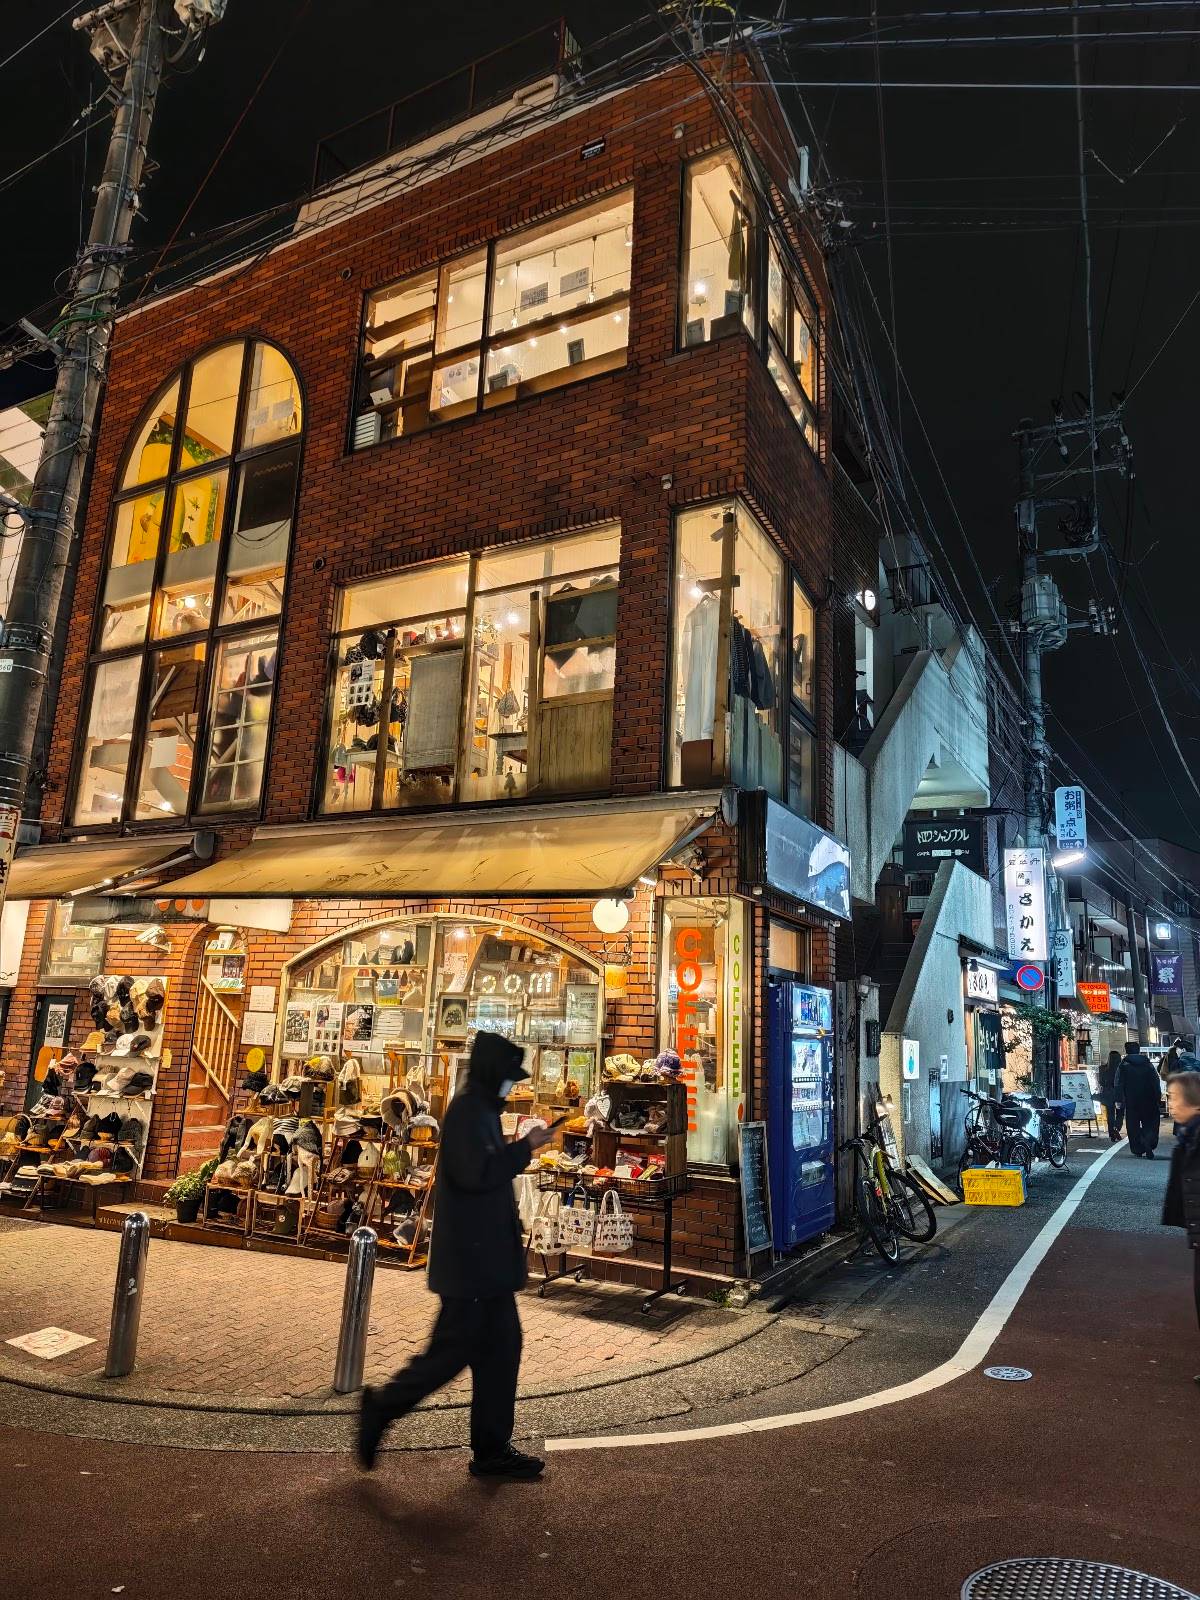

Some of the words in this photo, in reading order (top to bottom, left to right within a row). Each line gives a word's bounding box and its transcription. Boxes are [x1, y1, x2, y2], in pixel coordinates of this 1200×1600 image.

[1019, 892, 1034, 952] さかえ
[733, 934, 741, 1098] COFFEE
